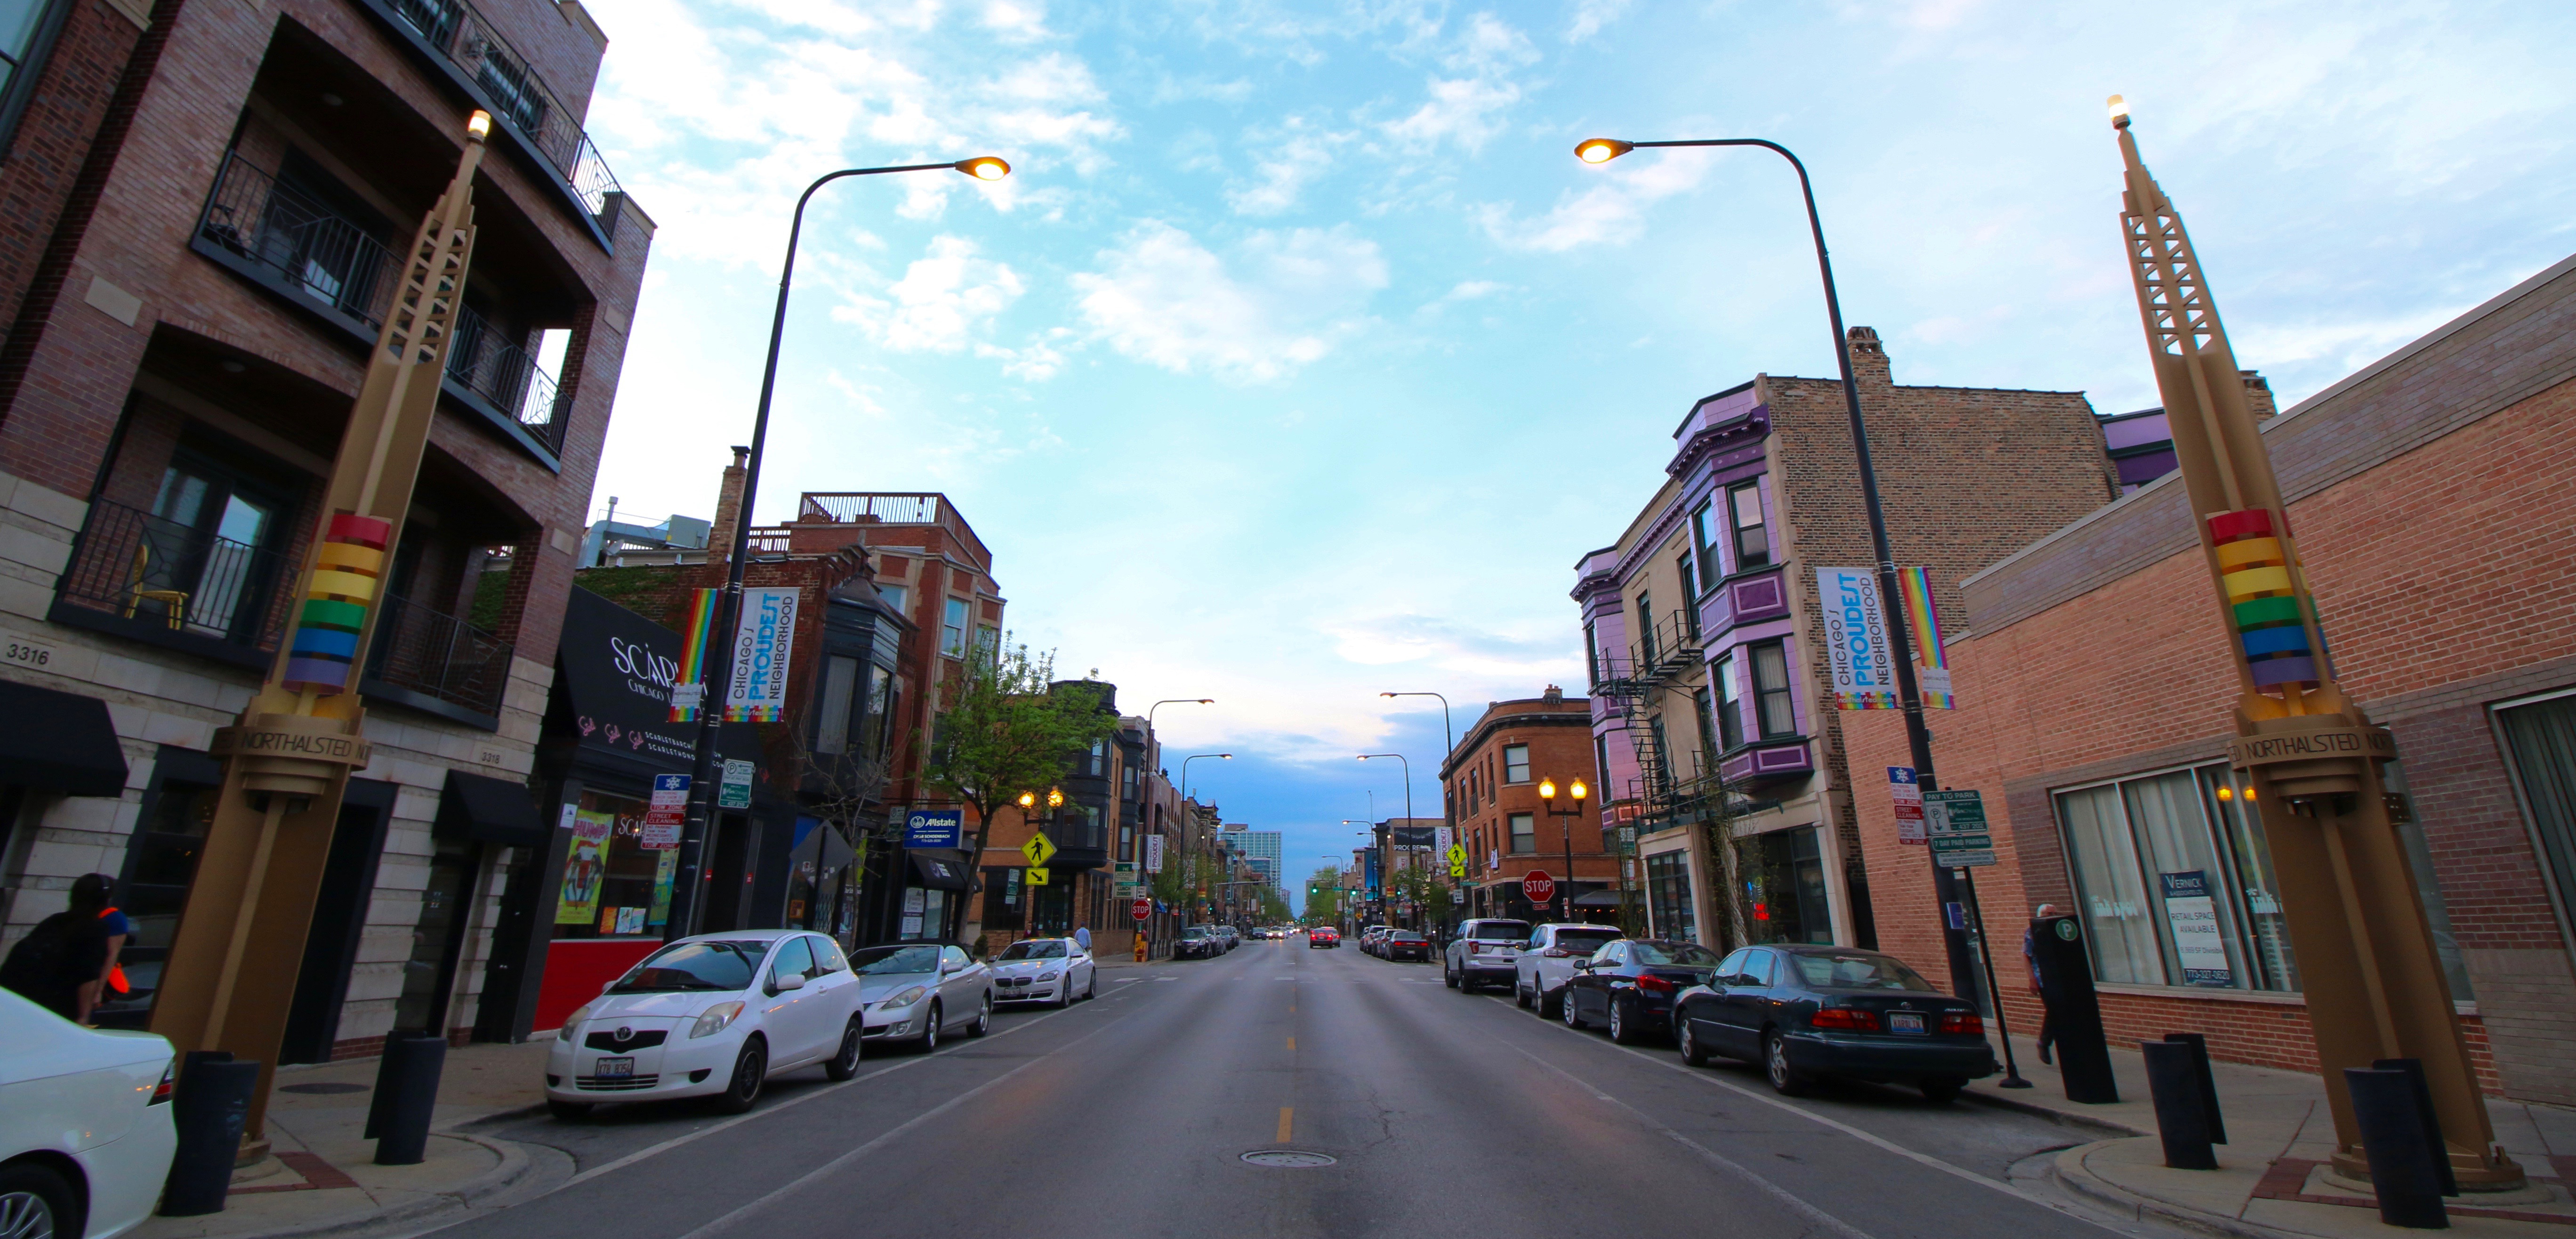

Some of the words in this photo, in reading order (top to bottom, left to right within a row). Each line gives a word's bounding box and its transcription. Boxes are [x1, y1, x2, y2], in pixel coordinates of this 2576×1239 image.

[1838, 573, 1875, 686] PROUDEST
[1860, 577, 1890, 685] NEIGHBORHOOD
[7, 644, 49, 664] 3316
[749, 593, 780, 700] PROUDEST
[769, 596, 793, 699] NEIGHBORHOOD
[1827, 609, 1851, 686] CHICAGO'S
[733, 627, 754, 699] CHICAGO'S
[628, 679, 664, 701] CHICAGO
[241, 732, 352, 757] NORTHALSTED
[2245, 733, 2359, 758] NORTHALSTED
[925, 818, 956, 826] Allstate
[1526, 880, 1551, 892] STOP
[2165, 875, 2203, 889] VERNICK
[1133, 906, 1149, 914] STOP
